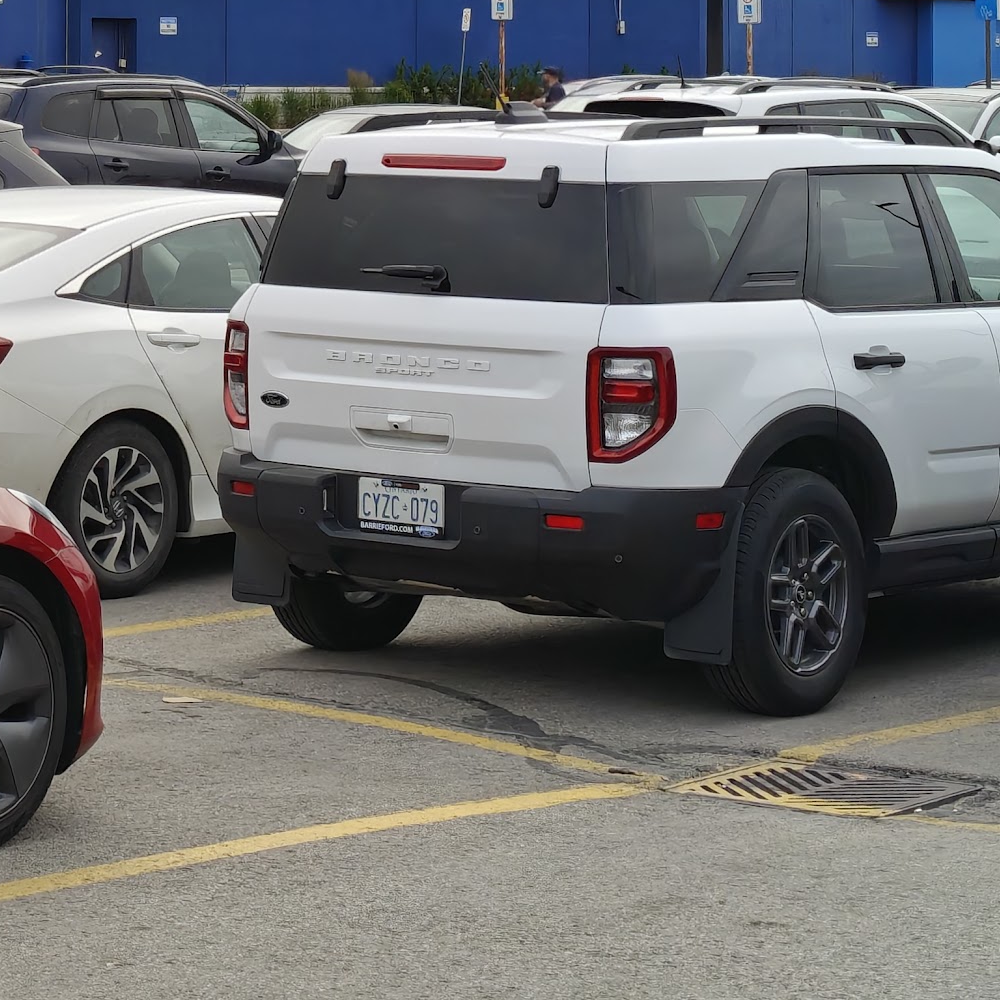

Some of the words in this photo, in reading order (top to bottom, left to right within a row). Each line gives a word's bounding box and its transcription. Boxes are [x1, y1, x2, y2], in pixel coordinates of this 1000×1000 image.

[325, 349, 491, 372] BRONCO
[374, 366, 435, 377] SPORT
[410, 497, 439, 524] 079
[360, 521, 414, 534] BARRIEFORD.COM
